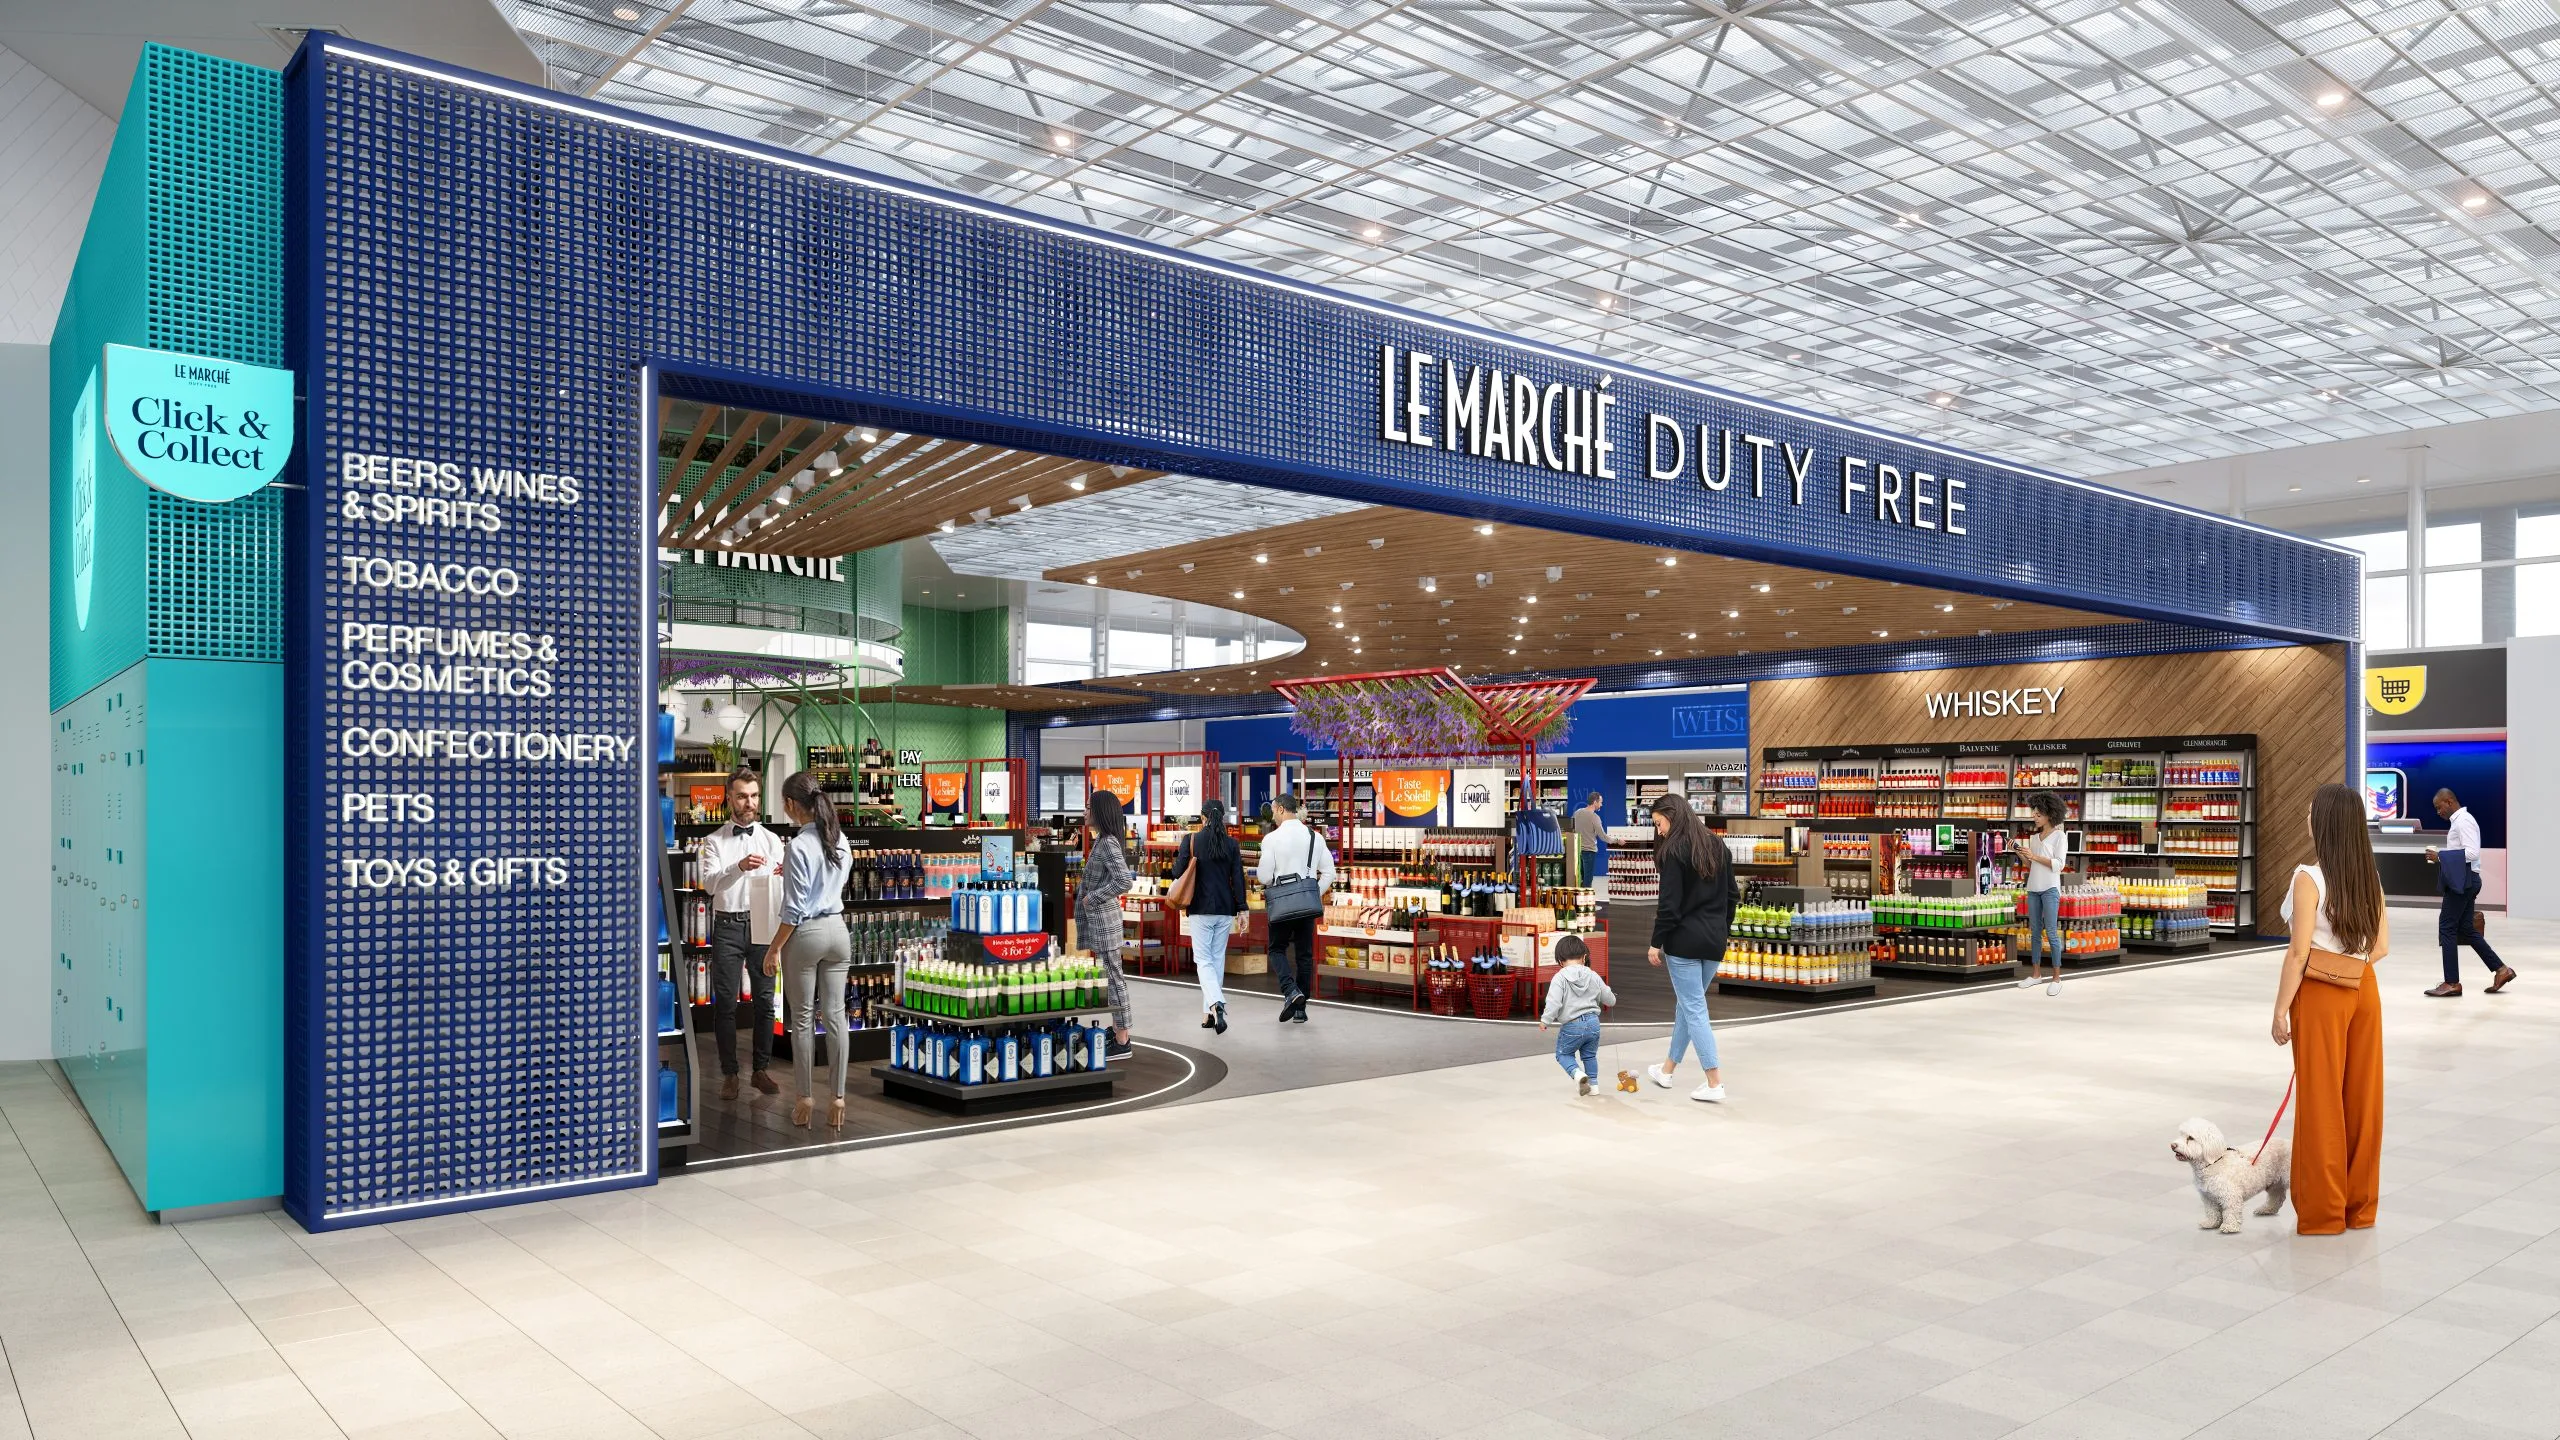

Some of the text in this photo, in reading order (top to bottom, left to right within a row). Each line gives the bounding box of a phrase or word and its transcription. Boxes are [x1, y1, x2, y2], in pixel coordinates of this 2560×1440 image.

[174, 363, 231, 385] LE MARCHÉ
[131, 396, 271, 441] Click &
[137, 430, 265, 471] Collect
[1379, 345, 1967, 535] LE MARCHÉ DUTY FREE
[342, 452, 580, 505] BEERS, WINES
[342, 491, 502, 532] & SPIRITS
[342, 556, 519, 596] TOBACCO
[342, 622, 559, 662] PERFUMES &
[342, 660, 552, 698] COSMETICS
[1925, 686, 2065, 719] WHISKEY
[342, 727, 636, 763] CONFECTIONERY
[900, 750, 922, 764] PAY
[2028, 743, 2067, 751] TALISKER
[1390, 789, 1431, 803] Le Soleil!
[1397, 777, 1422, 790] Taste
[1460, 789, 1491, 804] LE MARCHÉ
[342, 793, 435, 823] PETS
[342, 857, 568, 888] TOYS & GIFTS
[1010, 946, 1024, 956] for
[1025, 945, 1032, 955] 2
